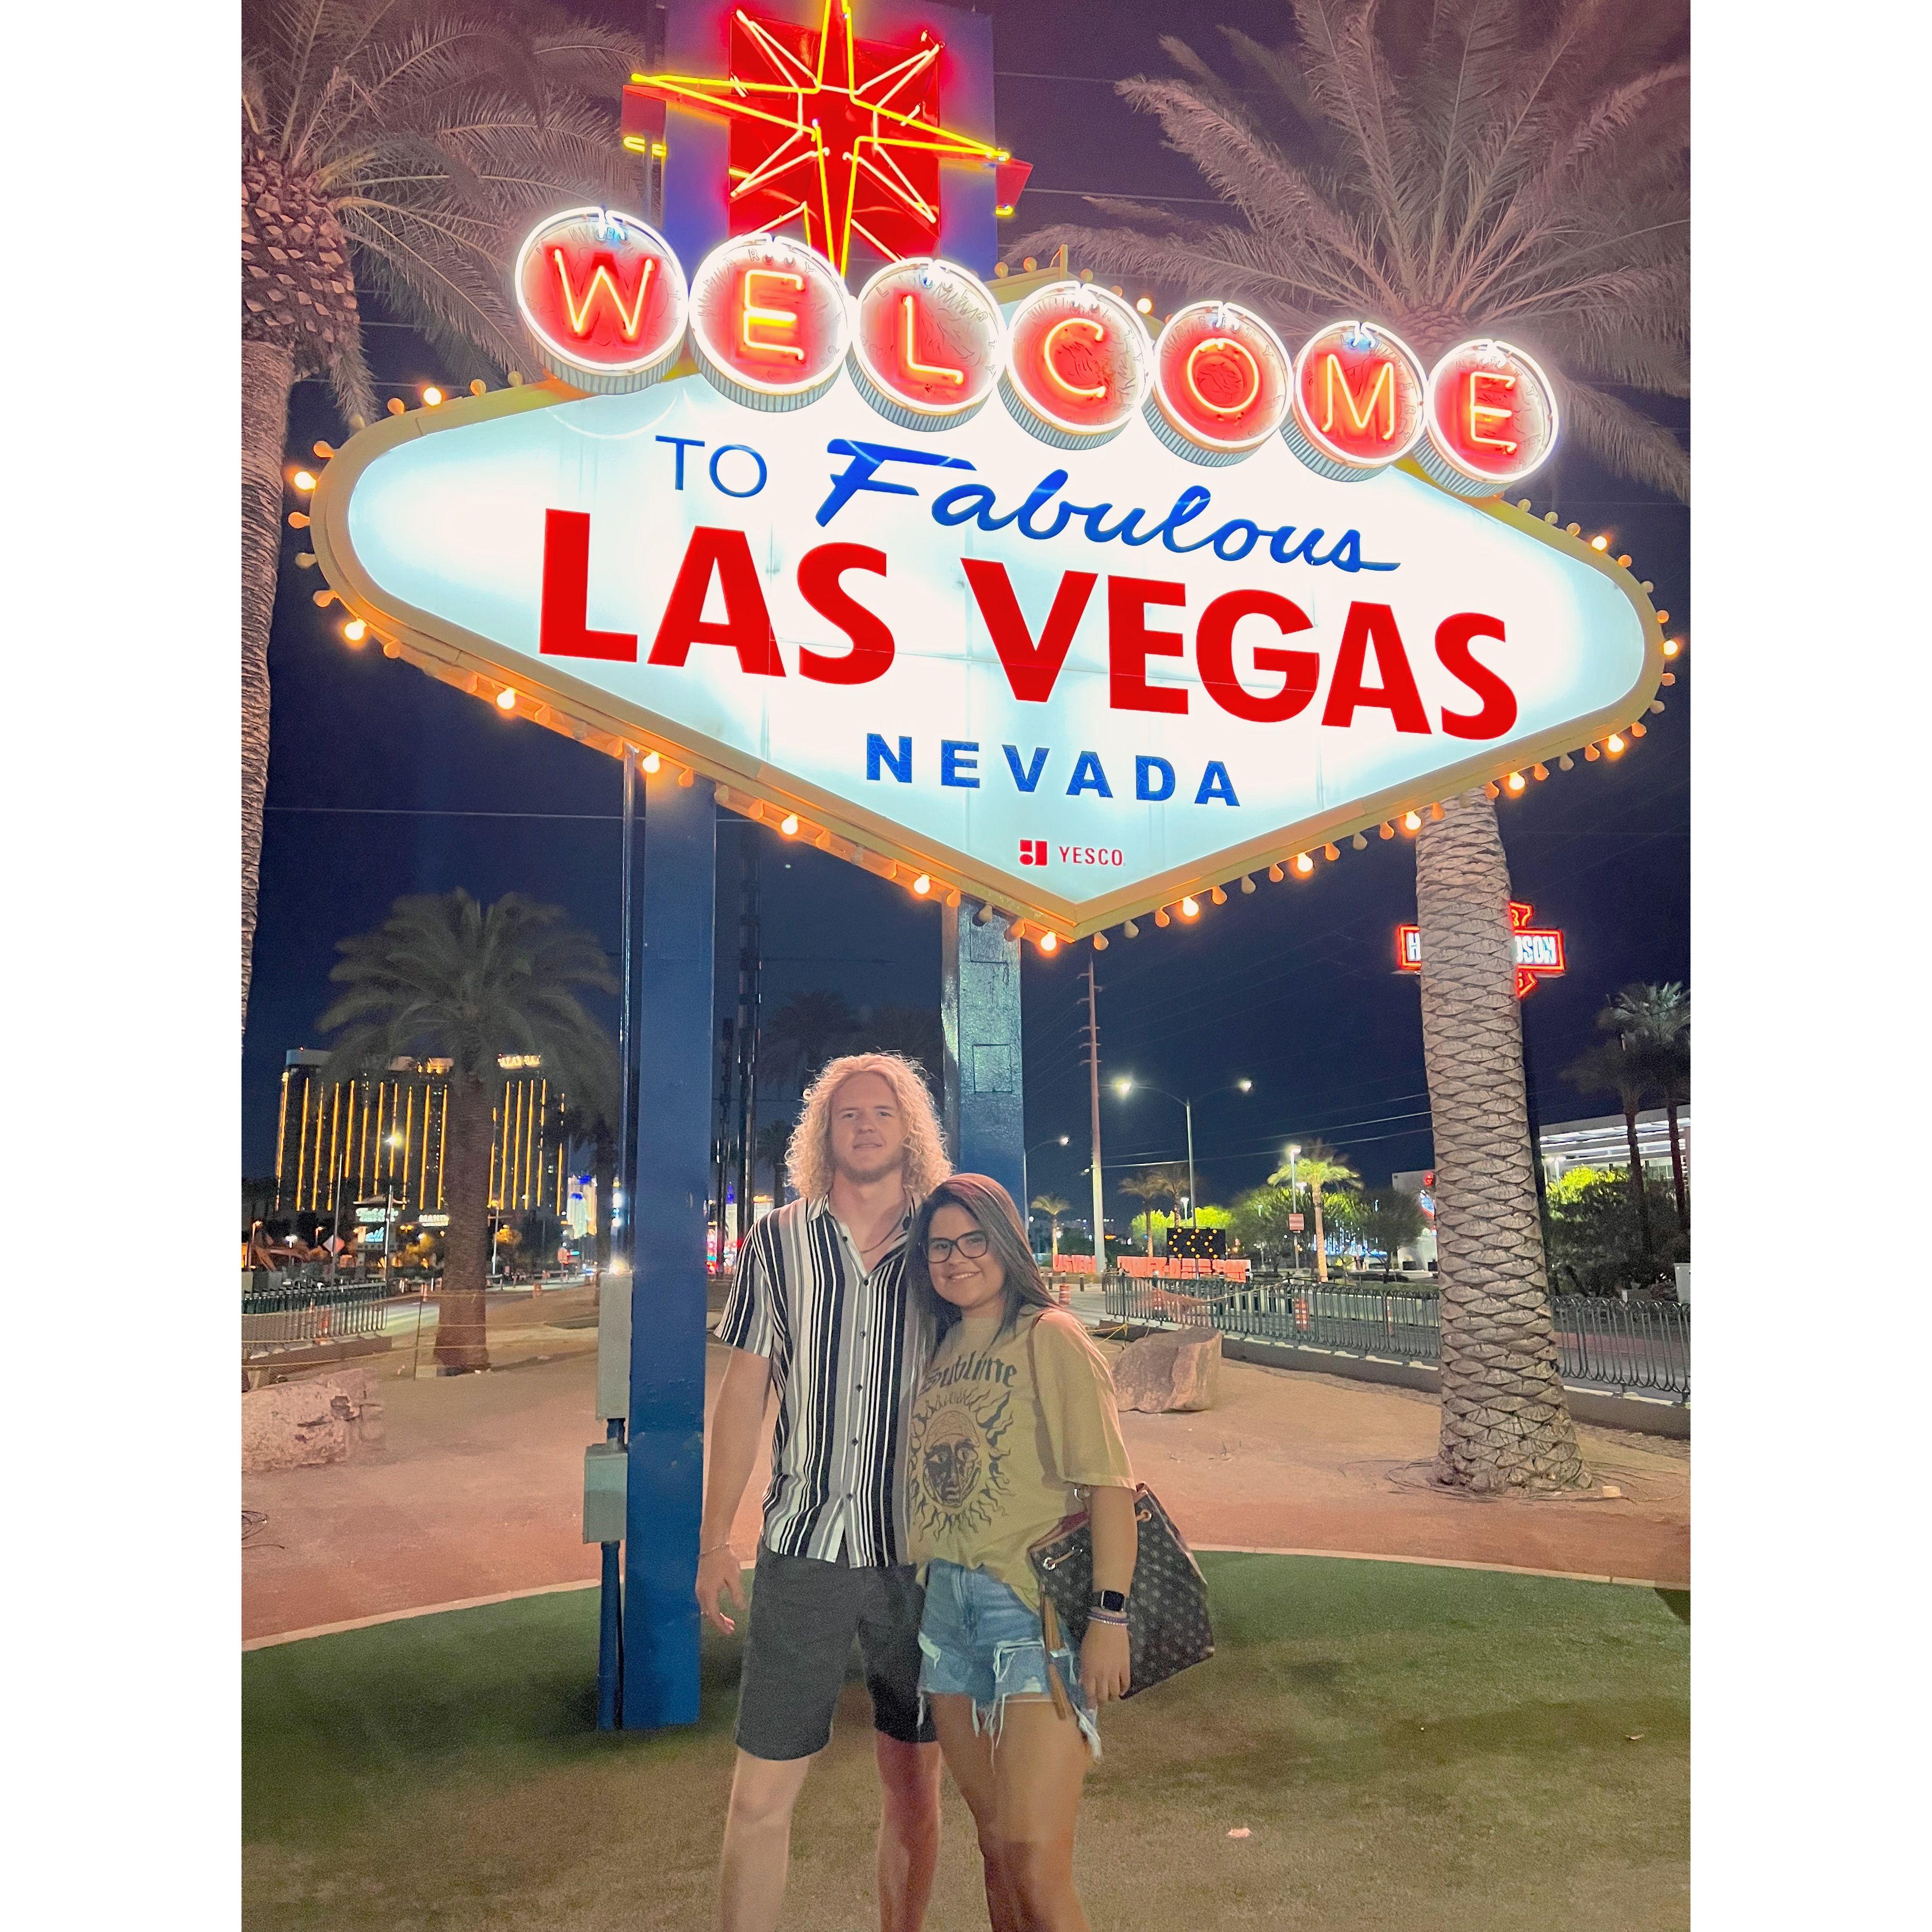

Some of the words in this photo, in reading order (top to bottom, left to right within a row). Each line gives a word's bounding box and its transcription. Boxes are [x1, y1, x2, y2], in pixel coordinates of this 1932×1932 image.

[541, 241, 1520, 459] WELCOME
[655, 435, 768, 498] TO
[816, 438, 1401, 573] Fabulous
[540, 509, 895, 685] LAS
[961, 558, 1518, 740] VEGAS
[866, 733, 1240, 807] NEVADA
[1058, 845, 1123, 867] YESCO
[918, 1350, 1018, 1397] Sublime
